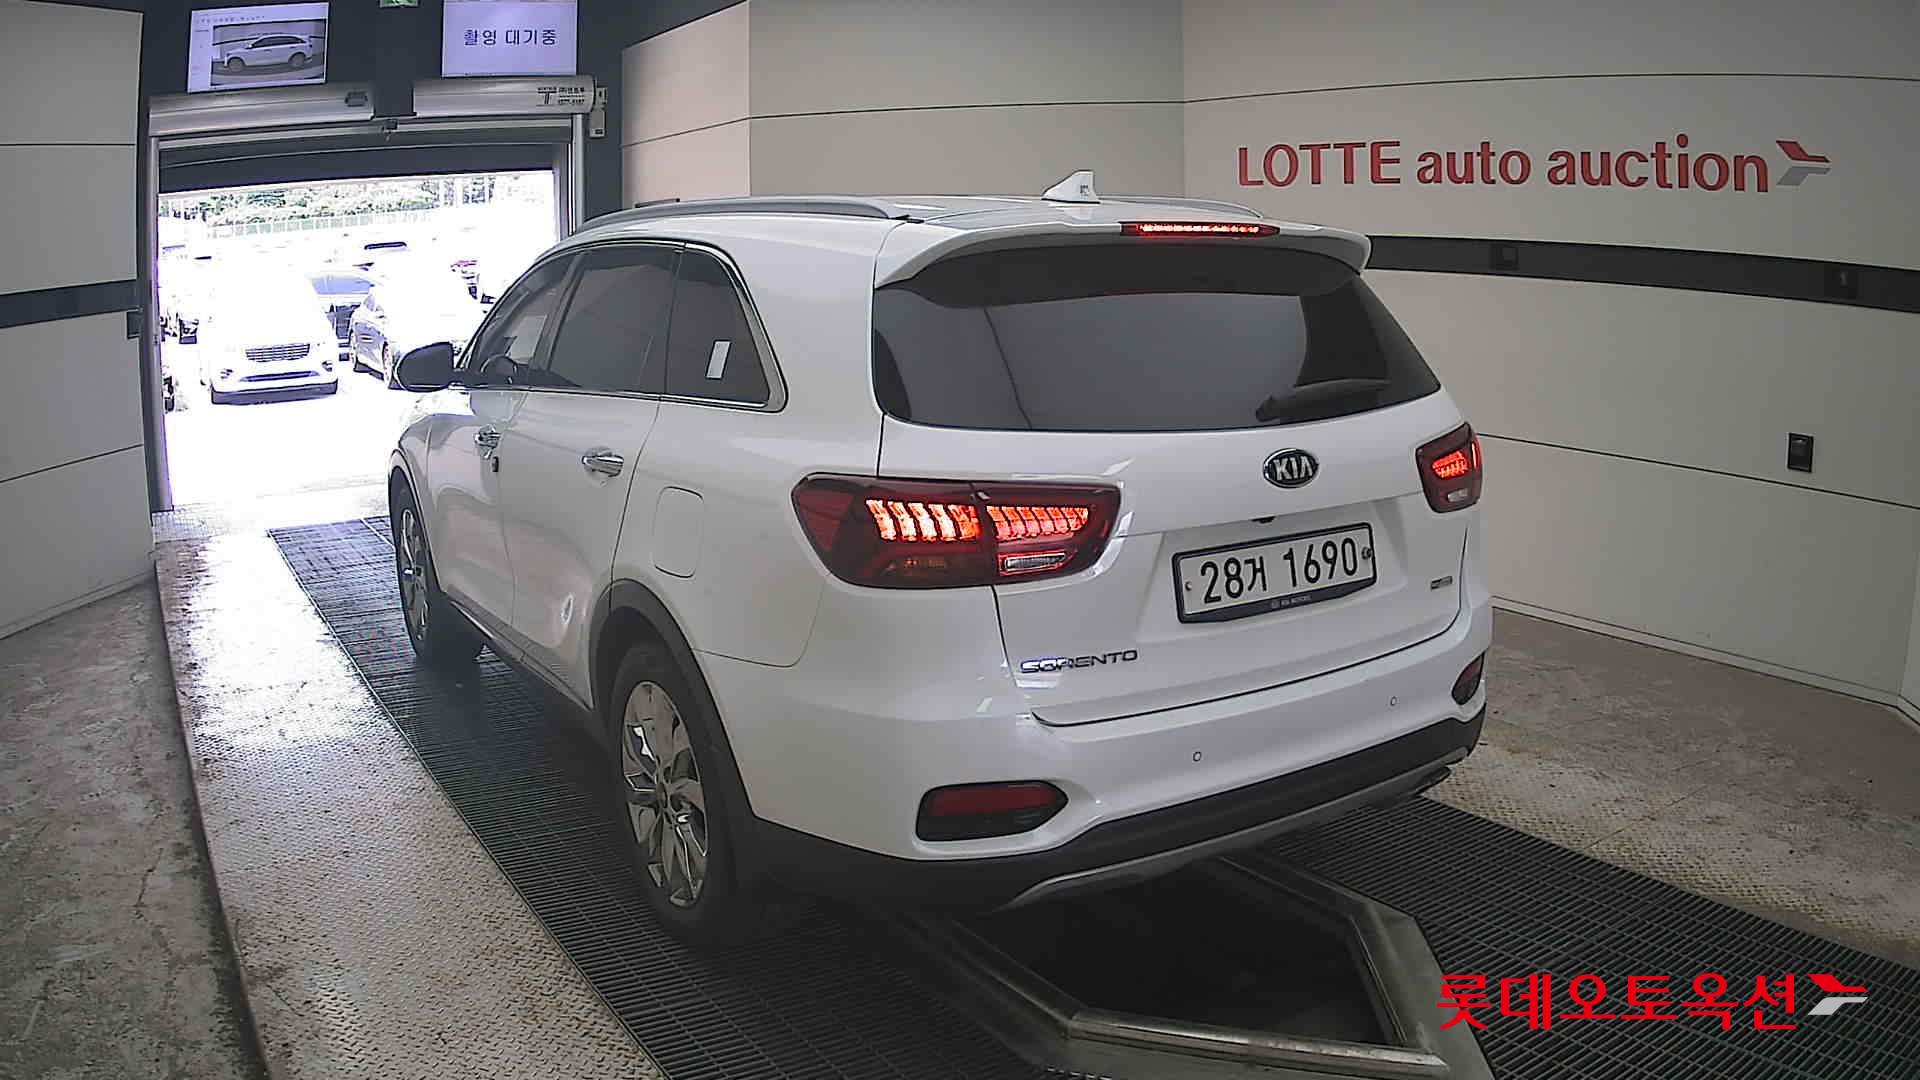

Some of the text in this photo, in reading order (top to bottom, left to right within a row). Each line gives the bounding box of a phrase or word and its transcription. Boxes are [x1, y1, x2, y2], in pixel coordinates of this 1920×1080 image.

[464, 29, 557, 46] 촬영 대기중
[1238, 133, 1769, 193] LOTTE auto auction
[1272, 455, 1314, 481] KIA
[1200, 537, 1358, 604] 28거 1690
[1020, 649, 1138, 674] SORENTO
